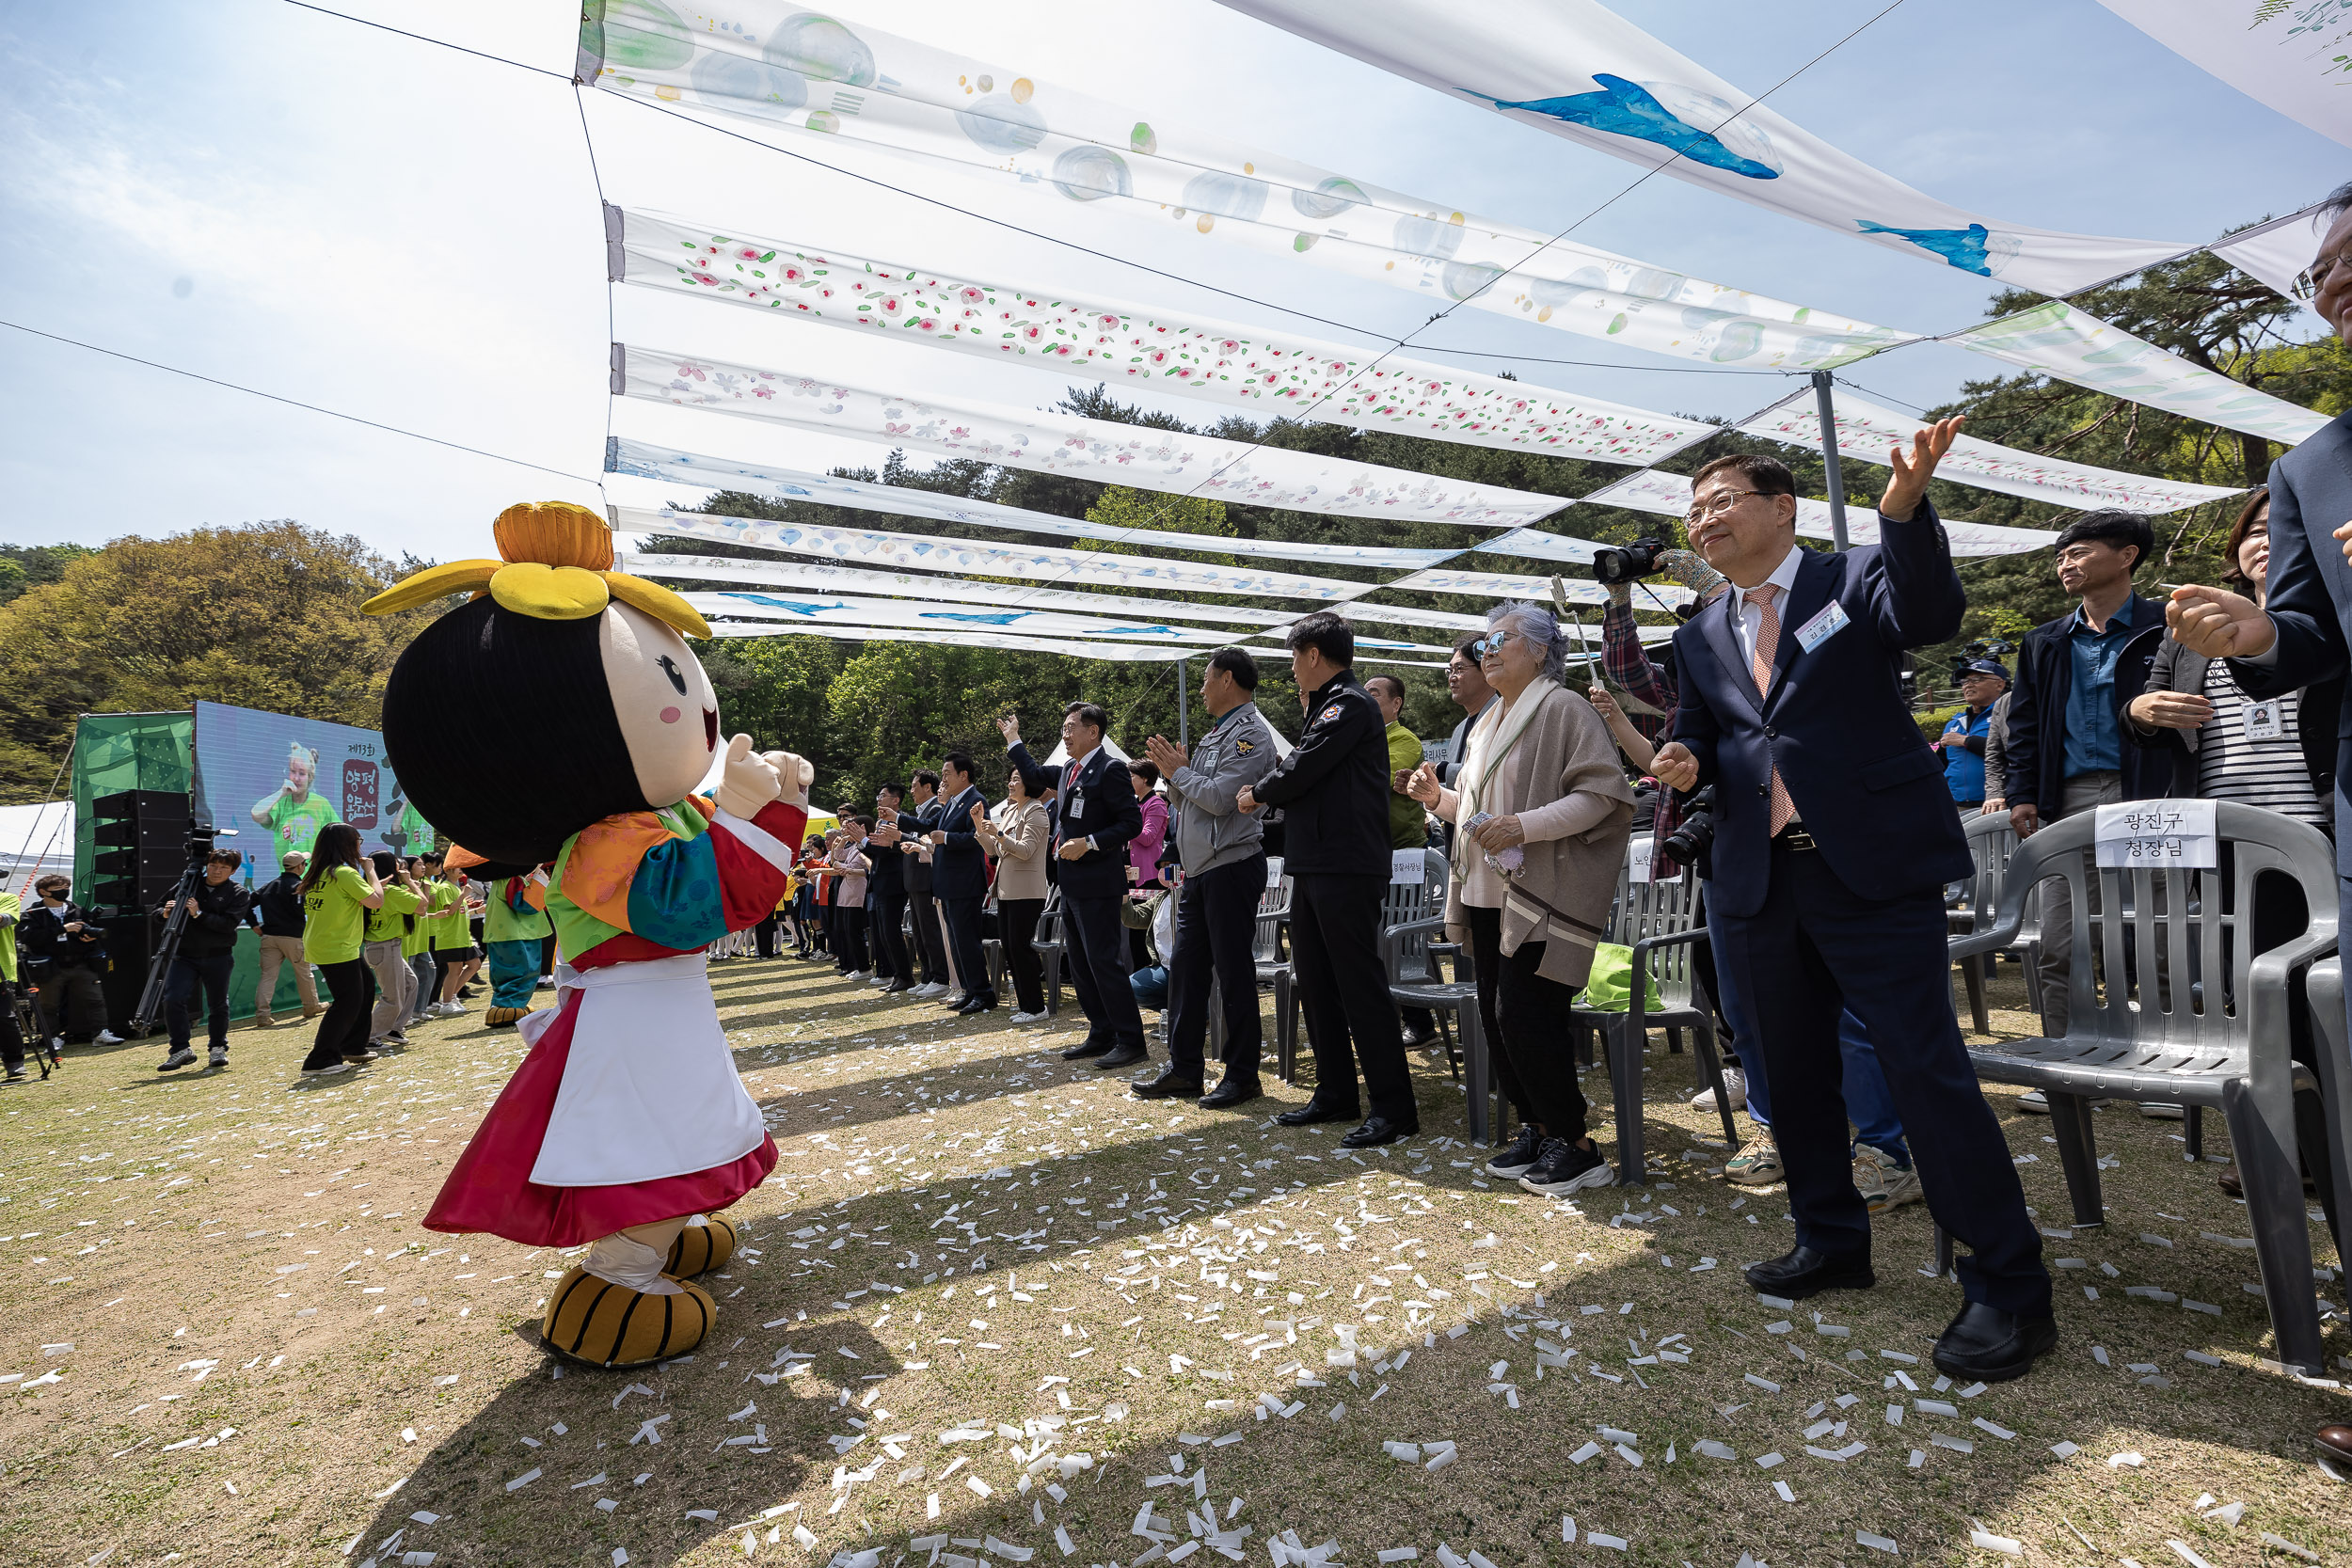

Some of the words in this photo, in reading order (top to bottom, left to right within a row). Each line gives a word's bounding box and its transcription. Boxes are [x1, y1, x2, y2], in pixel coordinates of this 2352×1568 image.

[348, 743, 375, 756] 제13회
[345, 769, 376, 795] 양평
[2123, 813, 2184, 831] 광진구
[2124, 839, 2182, 857] 청장님
[1392, 862, 1422, 872] 경찰서장님
